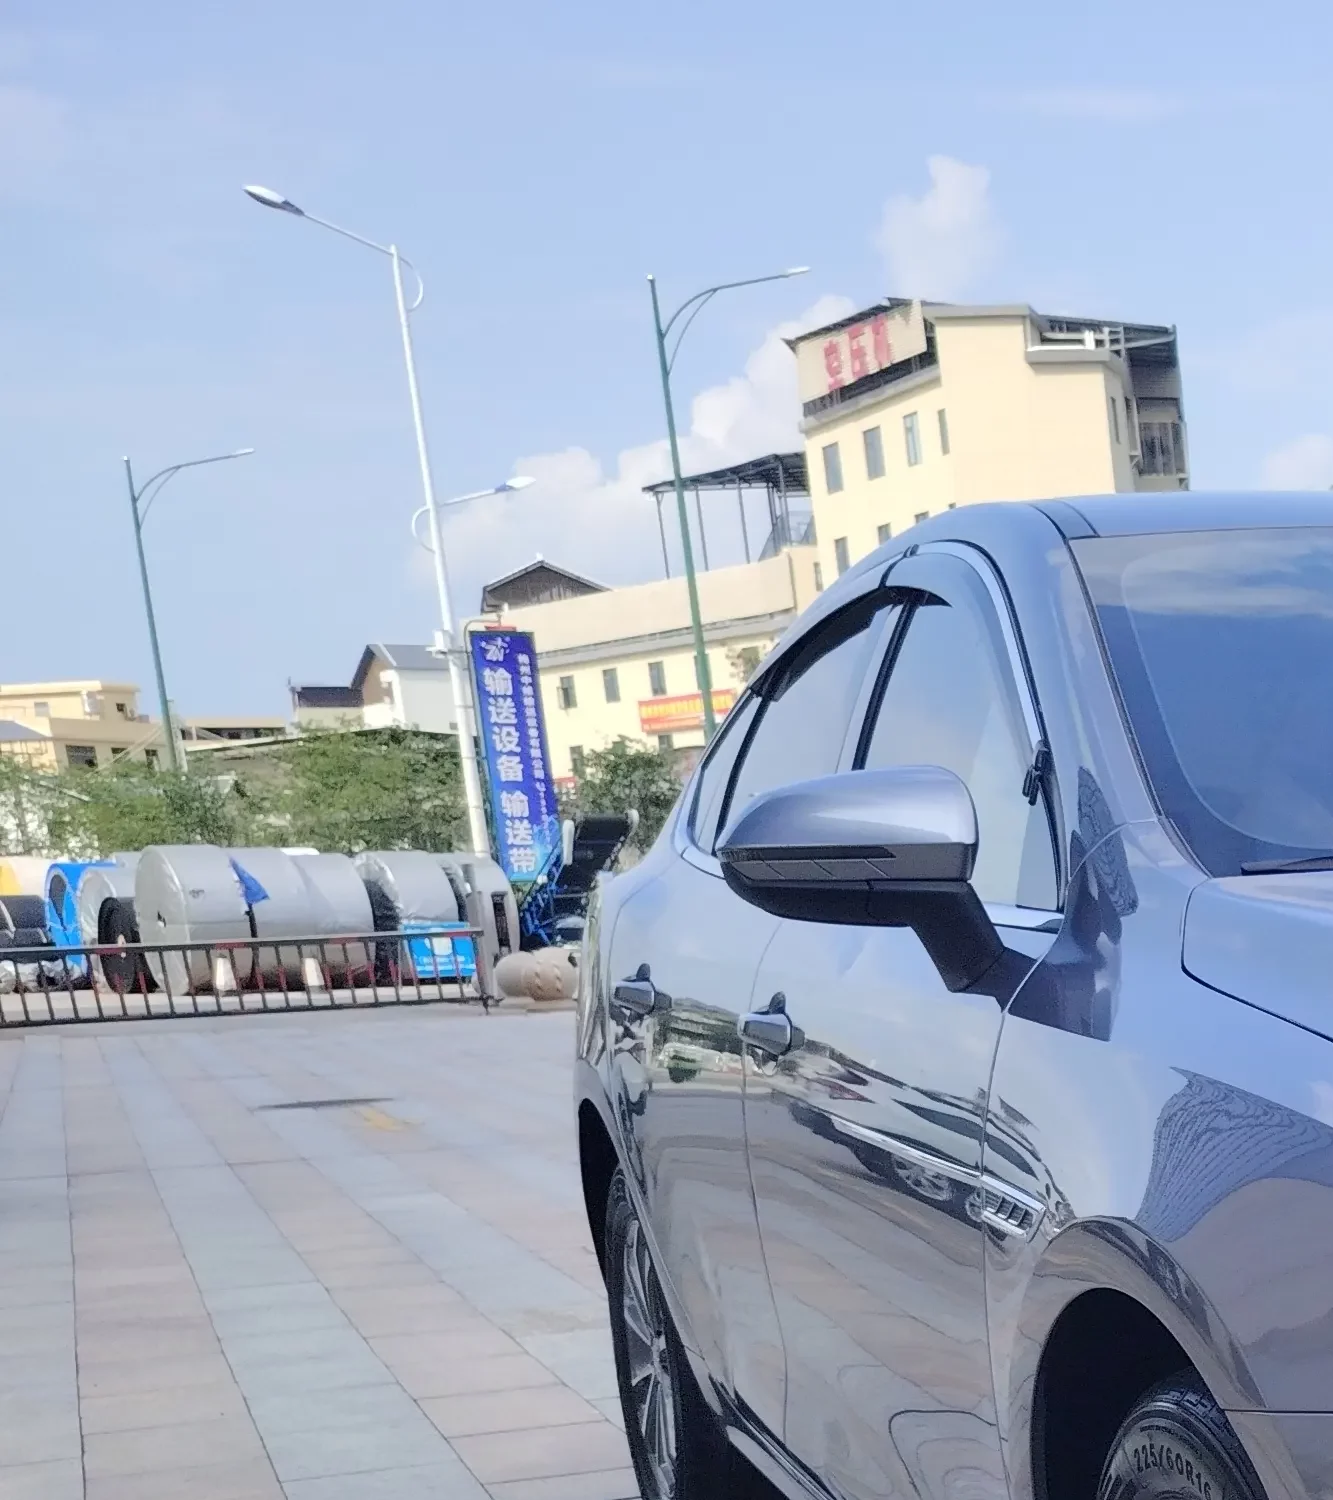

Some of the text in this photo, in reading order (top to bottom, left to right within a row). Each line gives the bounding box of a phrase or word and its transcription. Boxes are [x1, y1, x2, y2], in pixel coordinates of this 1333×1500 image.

[483, 667, 524, 782] 输送设备
[500, 790, 537, 873] 输送带
